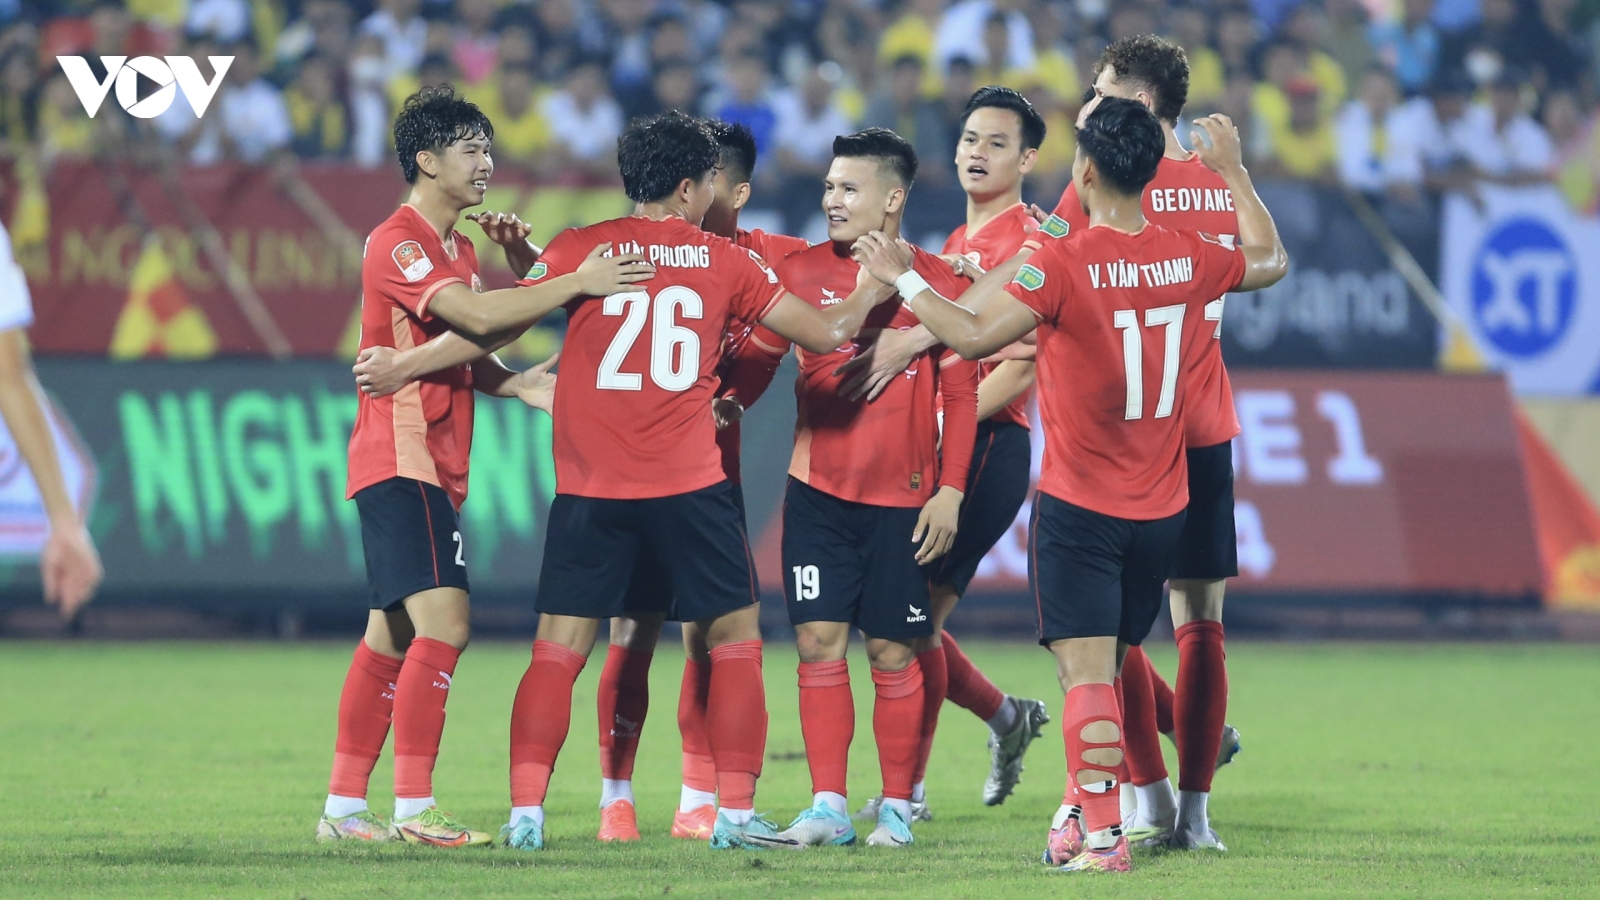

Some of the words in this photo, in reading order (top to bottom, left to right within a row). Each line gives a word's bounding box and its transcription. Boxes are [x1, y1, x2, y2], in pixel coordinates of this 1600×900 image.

[1150, 188, 1234, 212] GEOVANE
[1139, 256, 1193, 288] THANH
[596, 285, 703, 392] 26
[1113, 302, 1188, 421] 17
[792, 564, 821, 602] 19
